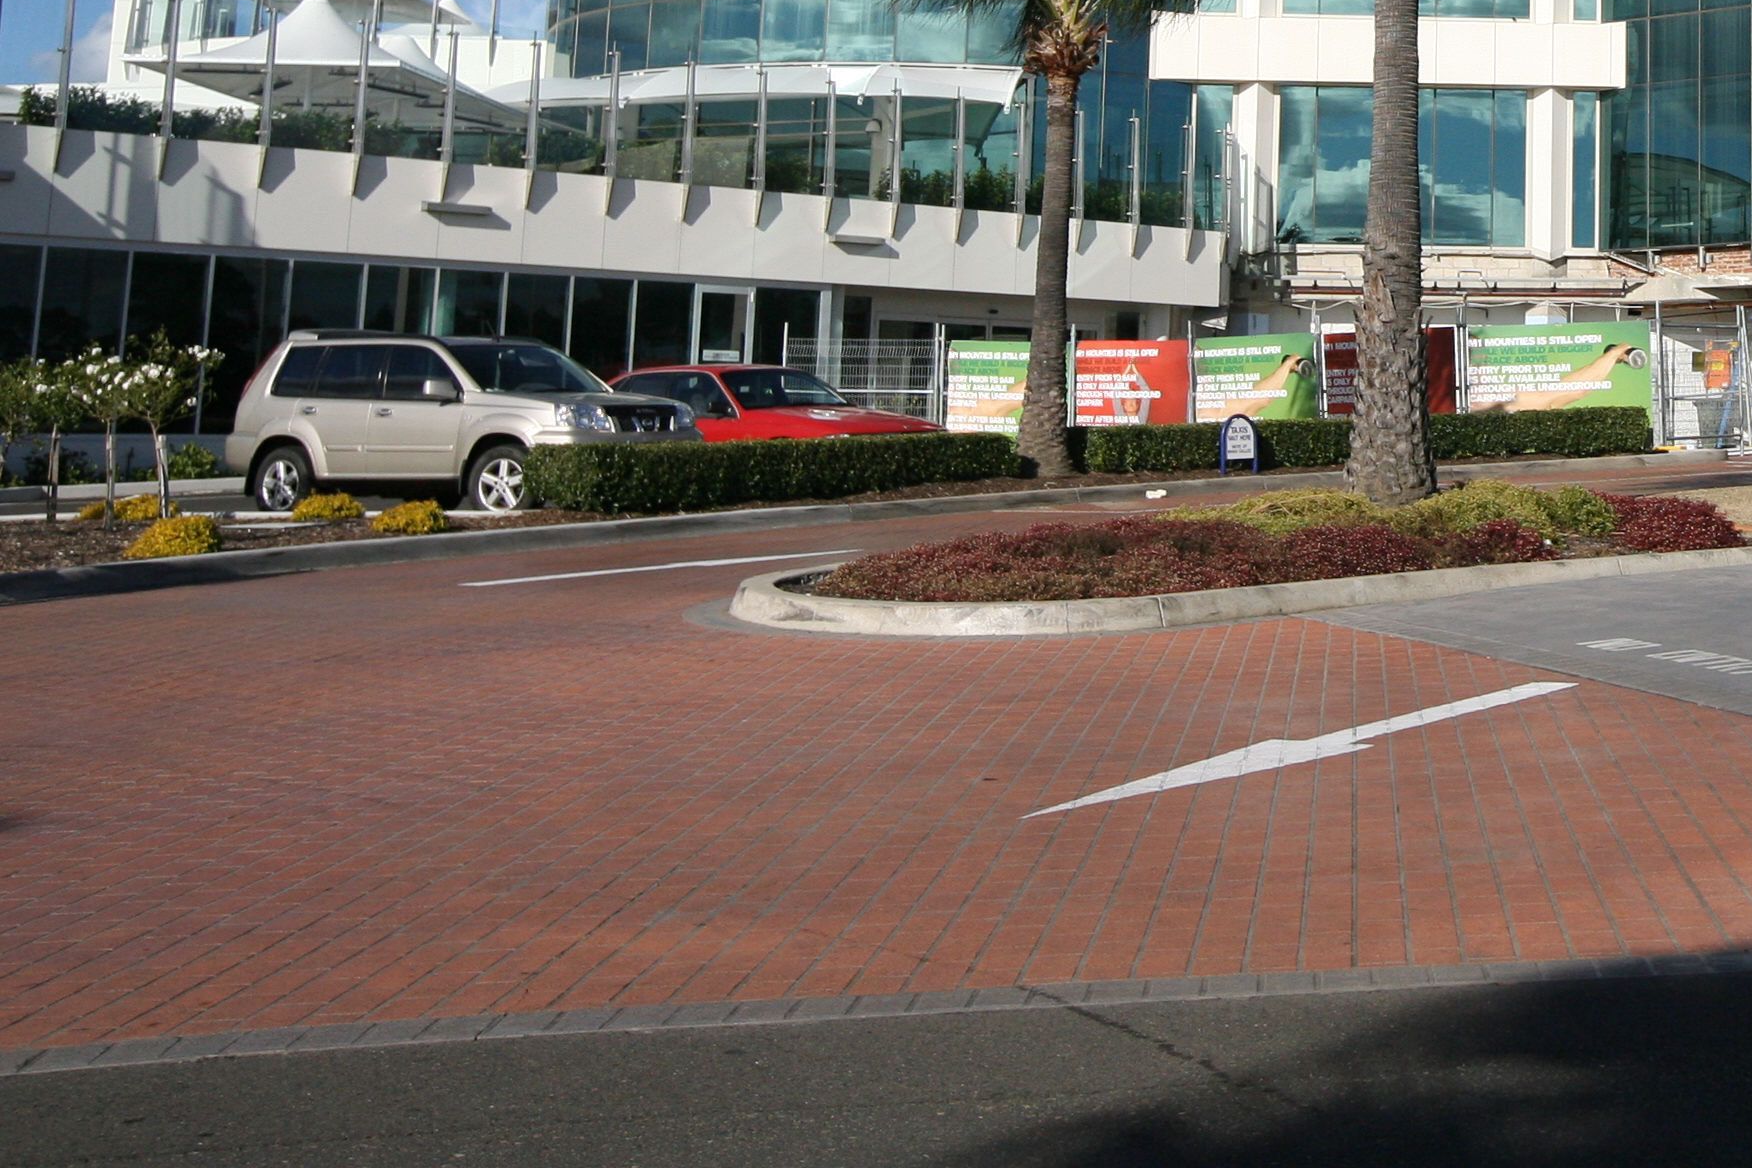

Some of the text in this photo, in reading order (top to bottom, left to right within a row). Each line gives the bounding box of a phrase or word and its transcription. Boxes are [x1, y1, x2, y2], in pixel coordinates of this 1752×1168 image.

[1485, 336, 1535, 347] MOUNTIES
[1537, 336, 1547, 344] IS
[1549, 336, 1573, 344] STILL
[1575, 335, 1602, 343] OPEN
[1468, 365, 1500, 375] ENTRY
[1502, 365, 1532, 373] PRIOR
[1480, 375, 1505, 383] ONLY
[1508, 374, 1560, 382] AVAILABLE
[1470, 381, 1612, 393] THROUGH THE UNDERGROUND
